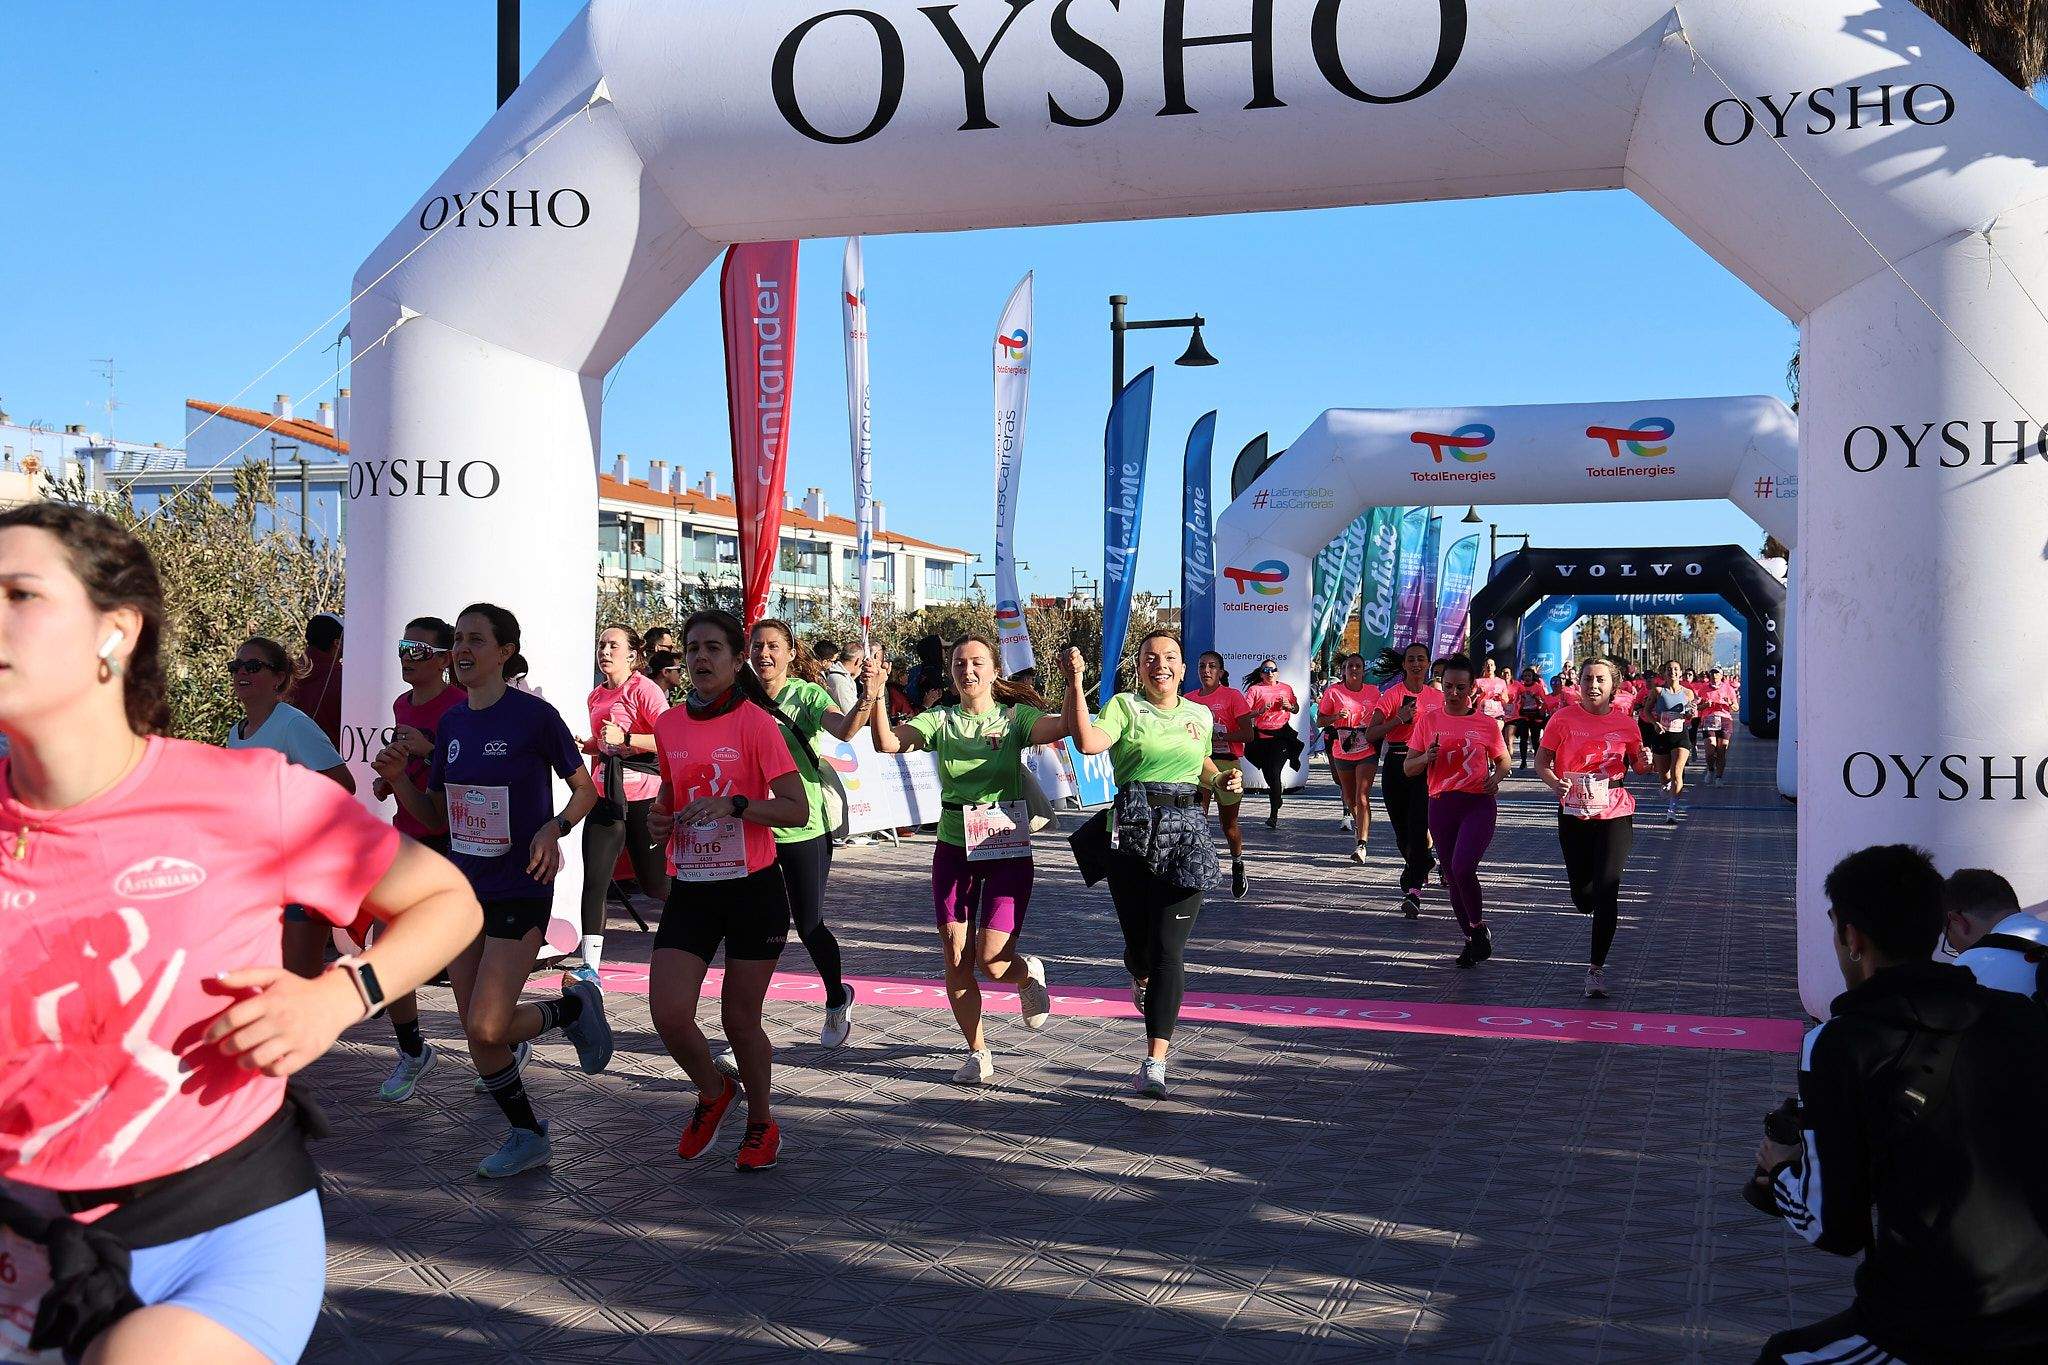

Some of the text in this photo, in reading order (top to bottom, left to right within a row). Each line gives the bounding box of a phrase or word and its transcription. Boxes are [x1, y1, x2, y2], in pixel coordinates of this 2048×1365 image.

[771, 0, 1467, 145] OYSHO
[1704, 83, 1955, 146] OYSHO
[418, 187, 591, 232] OYSHO
[1843, 420, 2048, 473] OYSH
[349, 459, 500, 499] OYSHO
[1410, 471, 1496, 483] TotalEnergies
[1586, 465, 1676, 478] TotalEnergies
[1776, 488, 1798, 498] Las
[1185, 486, 1214, 595] Marlene
[1555, 562, 1703, 577] VOLVO
[1363, 521, 1397, 639] Batiste
[1223, 602, 1289, 613] TotalEnergies
[1766, 619, 1777, 723] VOLVO
[1842, 751, 2048, 801] OYSH
[467, 816, 487, 829] 016
[988, 827, 1011, 837] 016
[694, 842, 722, 854] 016
[1181, 1000, 1411, 1019] OYSHO
[1477, 1016, 1747, 1036] OYSHO
